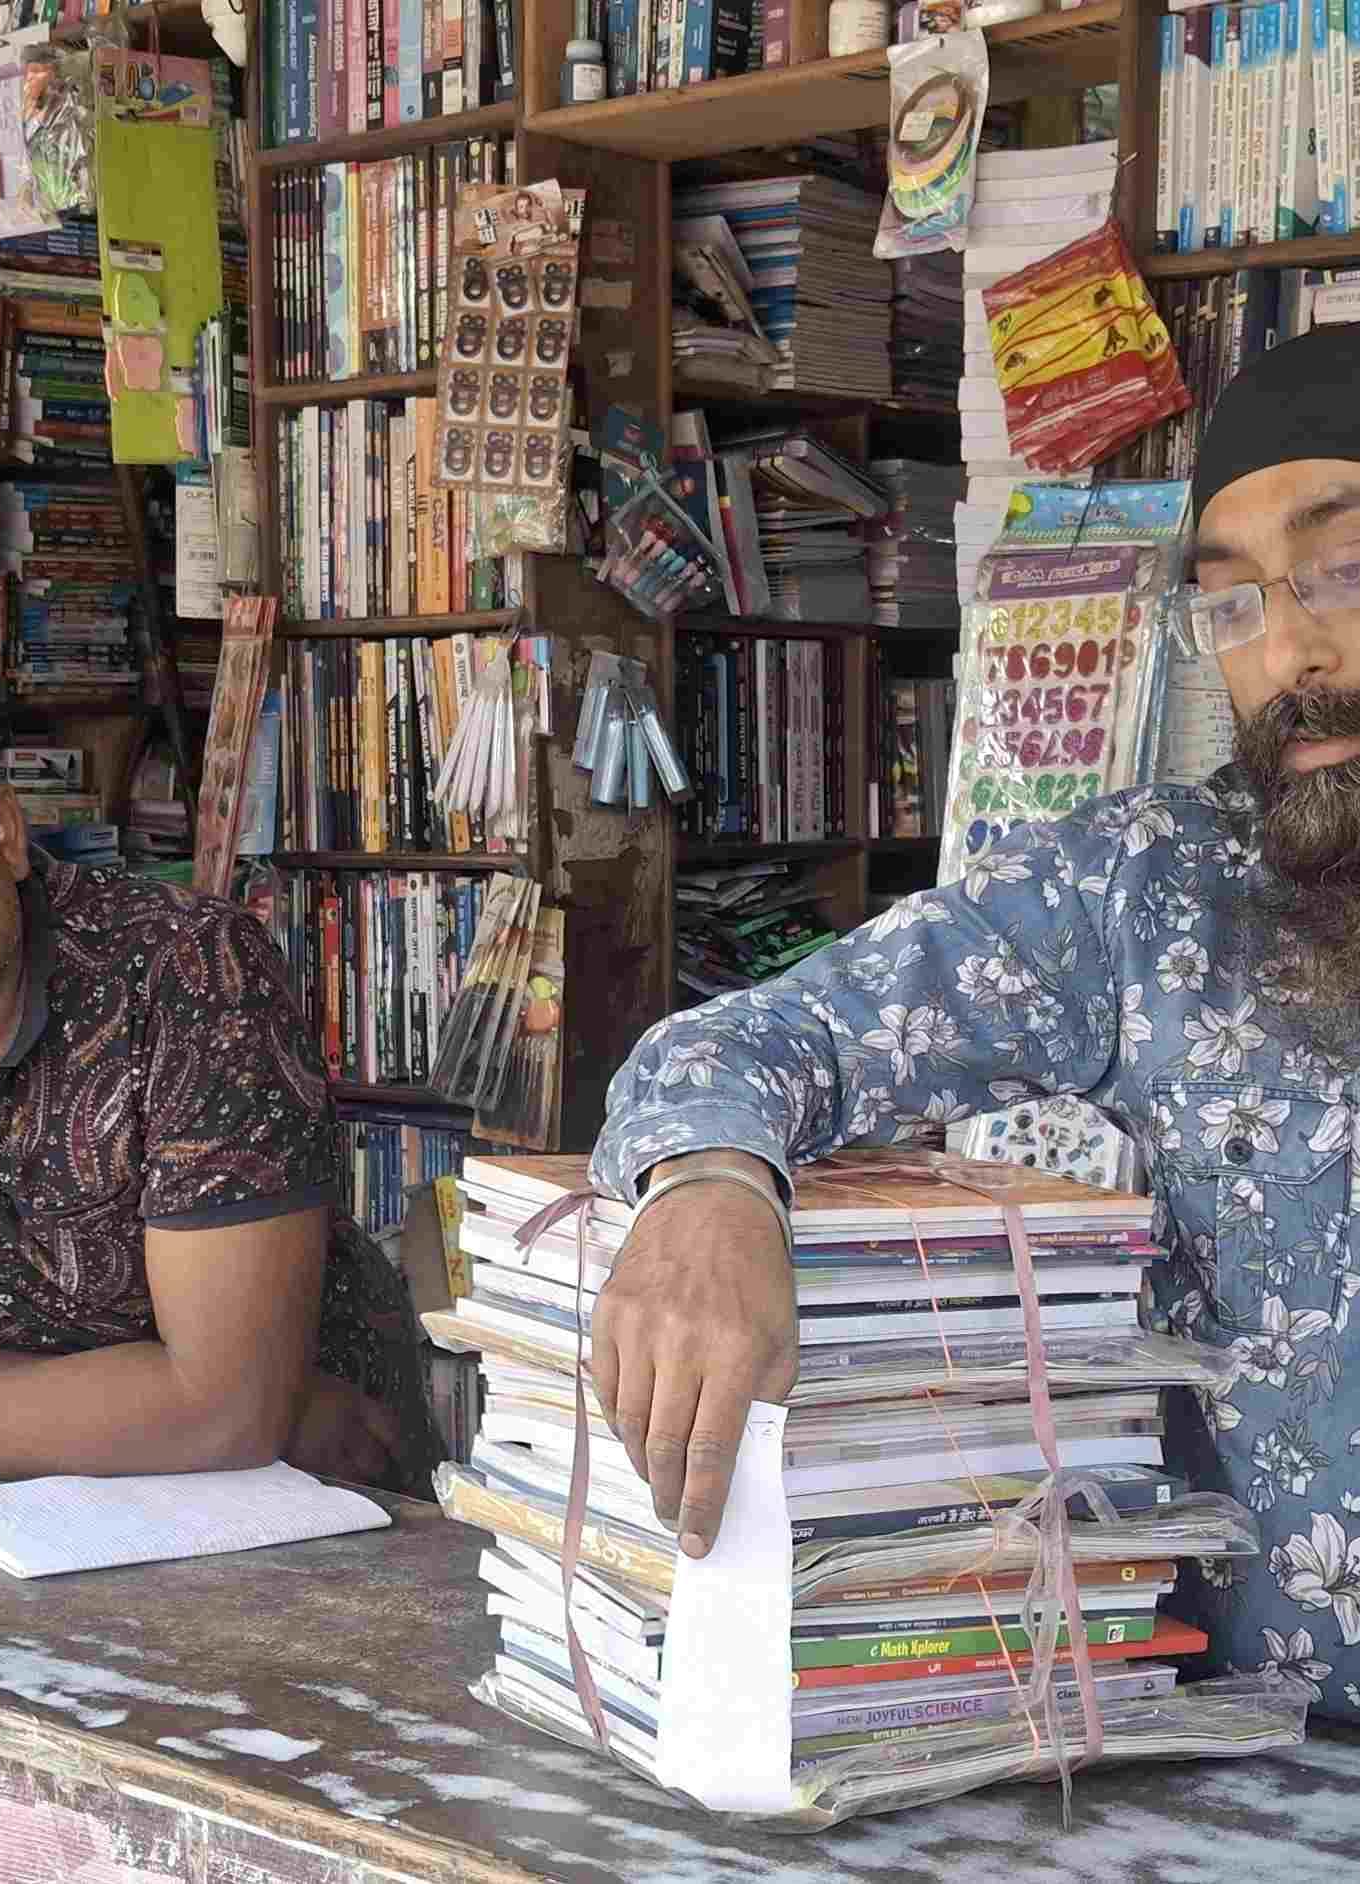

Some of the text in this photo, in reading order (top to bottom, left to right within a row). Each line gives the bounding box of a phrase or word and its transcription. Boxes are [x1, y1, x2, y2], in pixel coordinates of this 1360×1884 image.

[880, 1641, 909, 1657] Math
[911, 1638, 950, 1657] Xplorer
[864, 1706, 912, 1726] JOYFUL
[914, 1698, 984, 1720] SCIENCE
